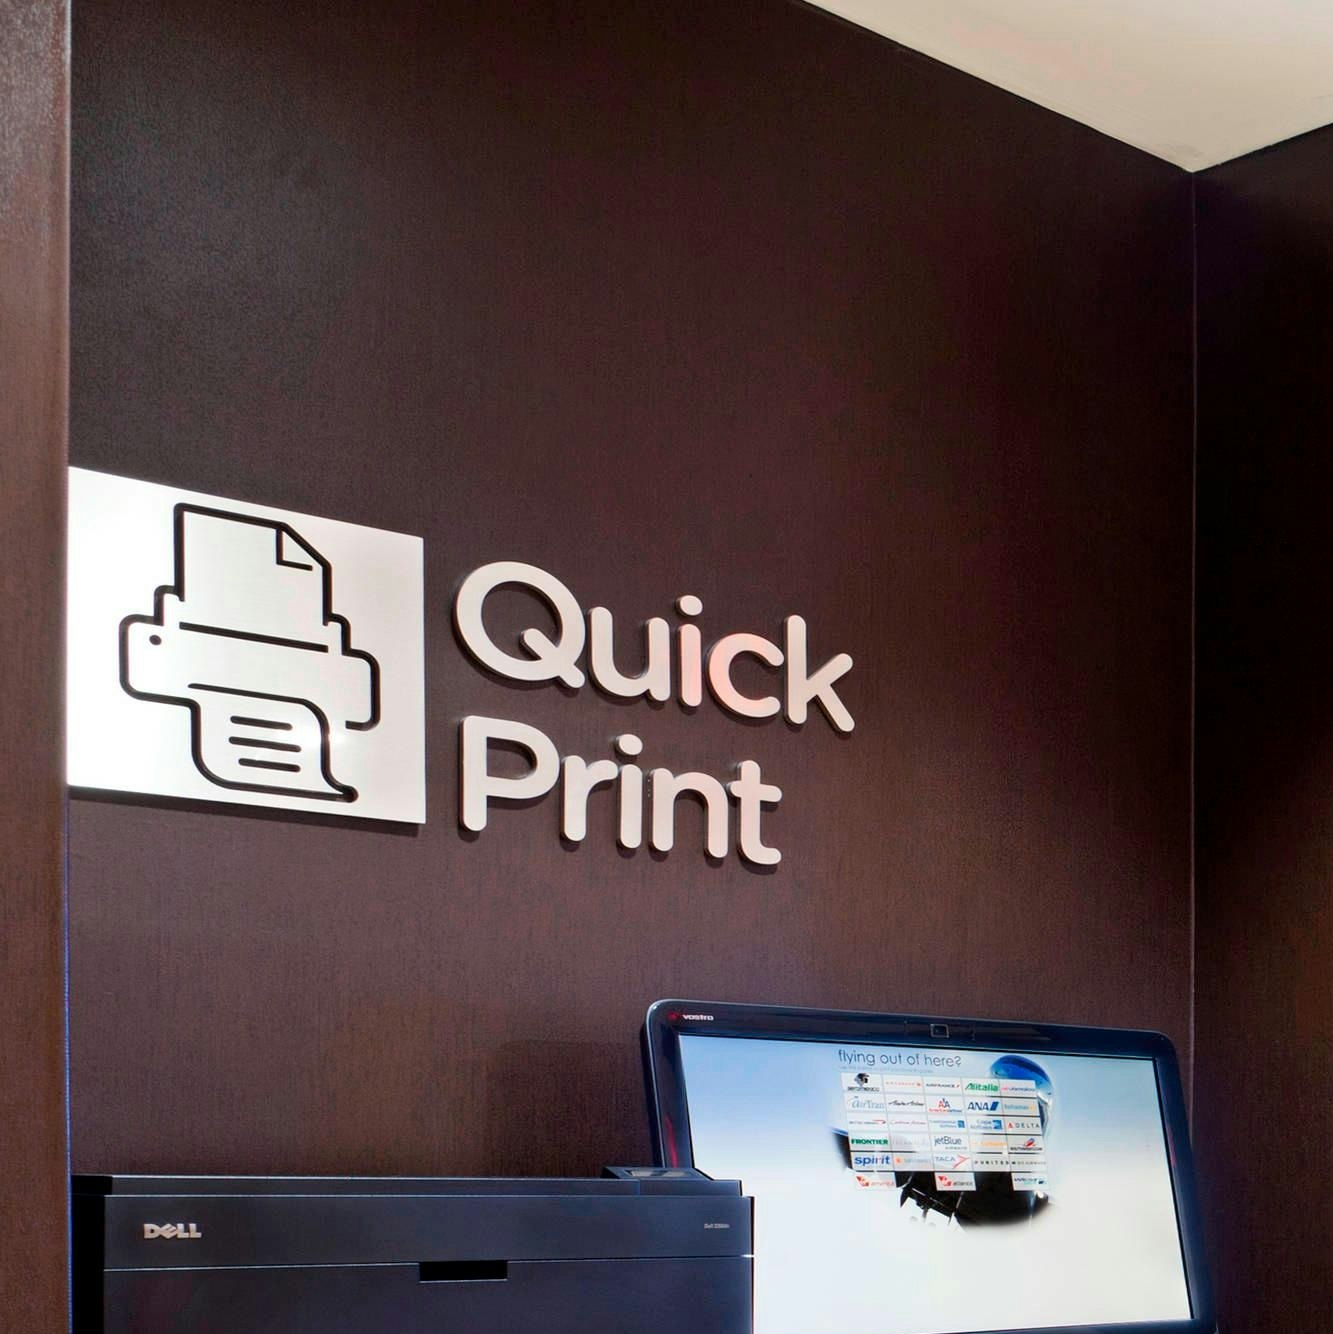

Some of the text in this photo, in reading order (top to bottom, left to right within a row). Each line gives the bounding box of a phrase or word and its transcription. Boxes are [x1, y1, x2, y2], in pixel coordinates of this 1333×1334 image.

[452, 560, 855, 733] Quick
[460, 714, 783, 867] Print
[838, 1049, 962, 1068] flying out of here?
[965, 1082, 999, 1092] Alitalia
[967, 1101, 989, 1110] ANA
[854, 1155, 891, 1167] spirit
[143, 1223, 202, 1239] DELL
